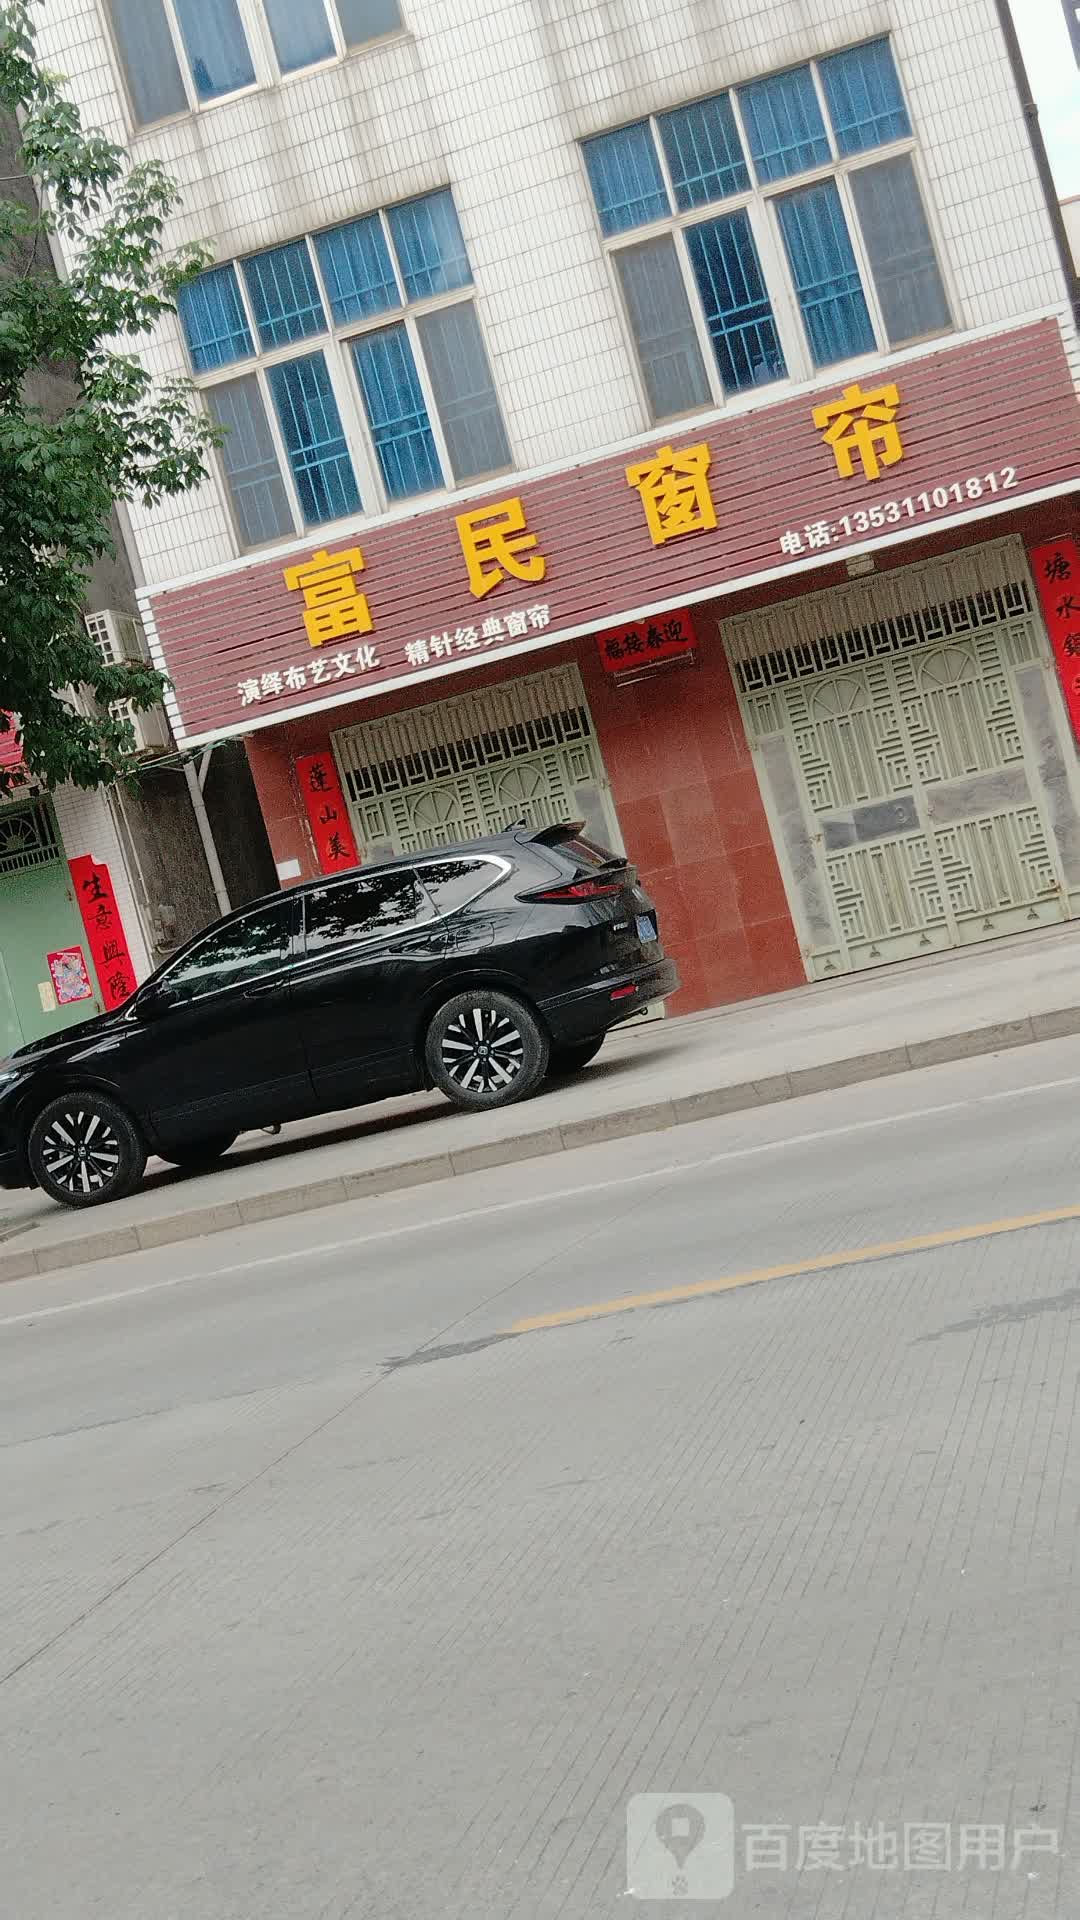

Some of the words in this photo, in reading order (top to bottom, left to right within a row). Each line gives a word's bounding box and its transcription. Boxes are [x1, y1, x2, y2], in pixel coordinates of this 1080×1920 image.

[282, 383, 906, 648] 富民窗帘
[779, 465, 1019, 556] 电话:13531101812
[237, 644, 381, 707] 演绎布艺文化
[404, 603, 552, 667] 精针经典窗帘
